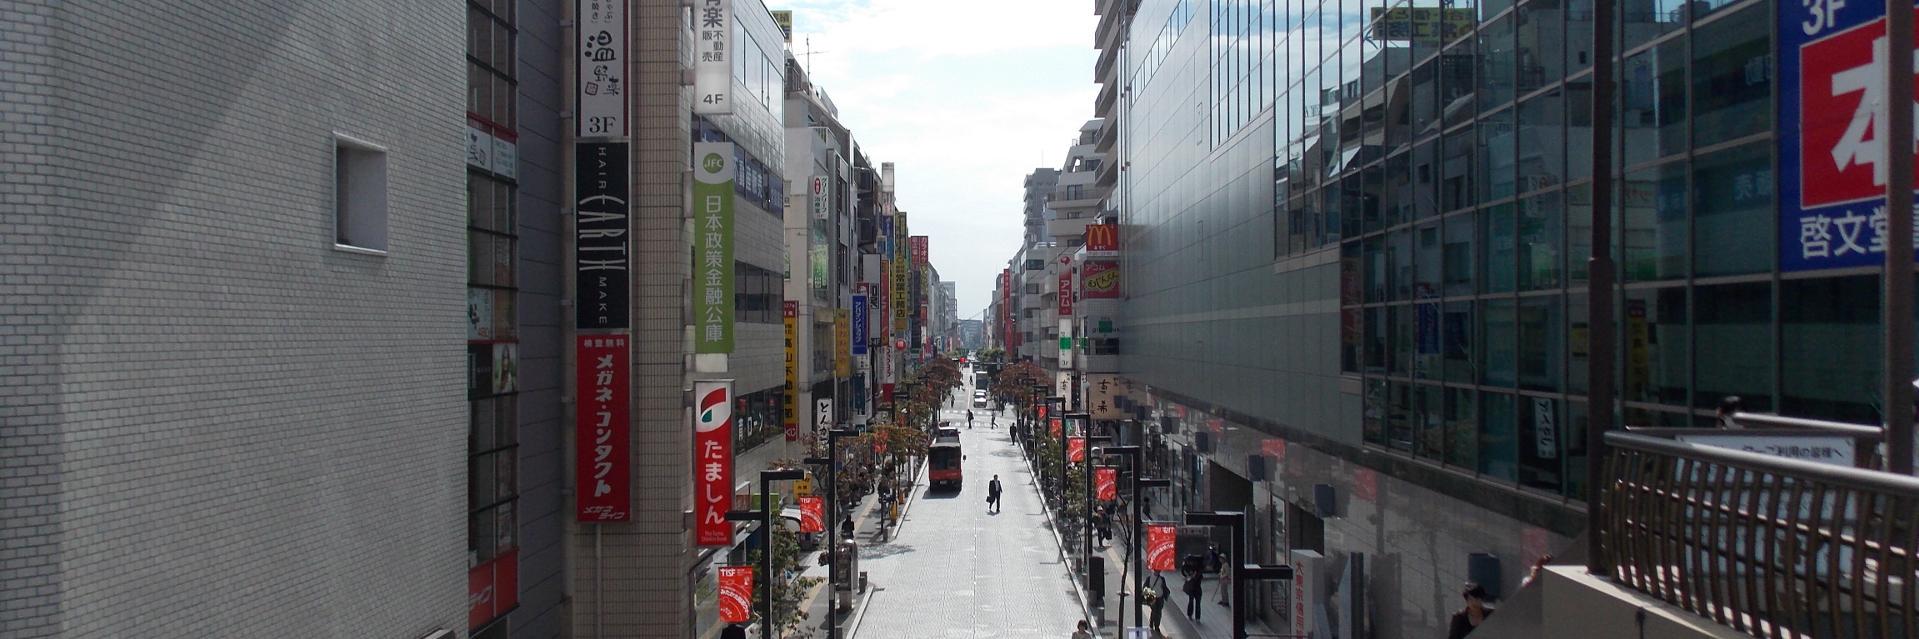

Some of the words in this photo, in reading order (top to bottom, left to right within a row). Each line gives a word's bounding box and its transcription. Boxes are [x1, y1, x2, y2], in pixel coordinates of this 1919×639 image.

[1803, 0, 1846, 35] 3F
[713, 31, 724, 62] 不動産
[703, 94, 723, 105] 4F
[589, 116, 616, 133] 3F
[598, 147, 608, 189] HAIR
[704, 158, 723, 168] JFC
[578, 195, 626, 271] EARTH
[1799, 204, 1919, 260] 啓文堂
[705, 195, 723, 342] 日本政策金融公庫
[598, 277, 608, 324] MAKE
[1060, 279, 1070, 307] アコム
[594, 354, 614, 497] メガネ・コンタクト
[705, 440, 724, 525] たましん
[720, 568, 736, 577] TISF
